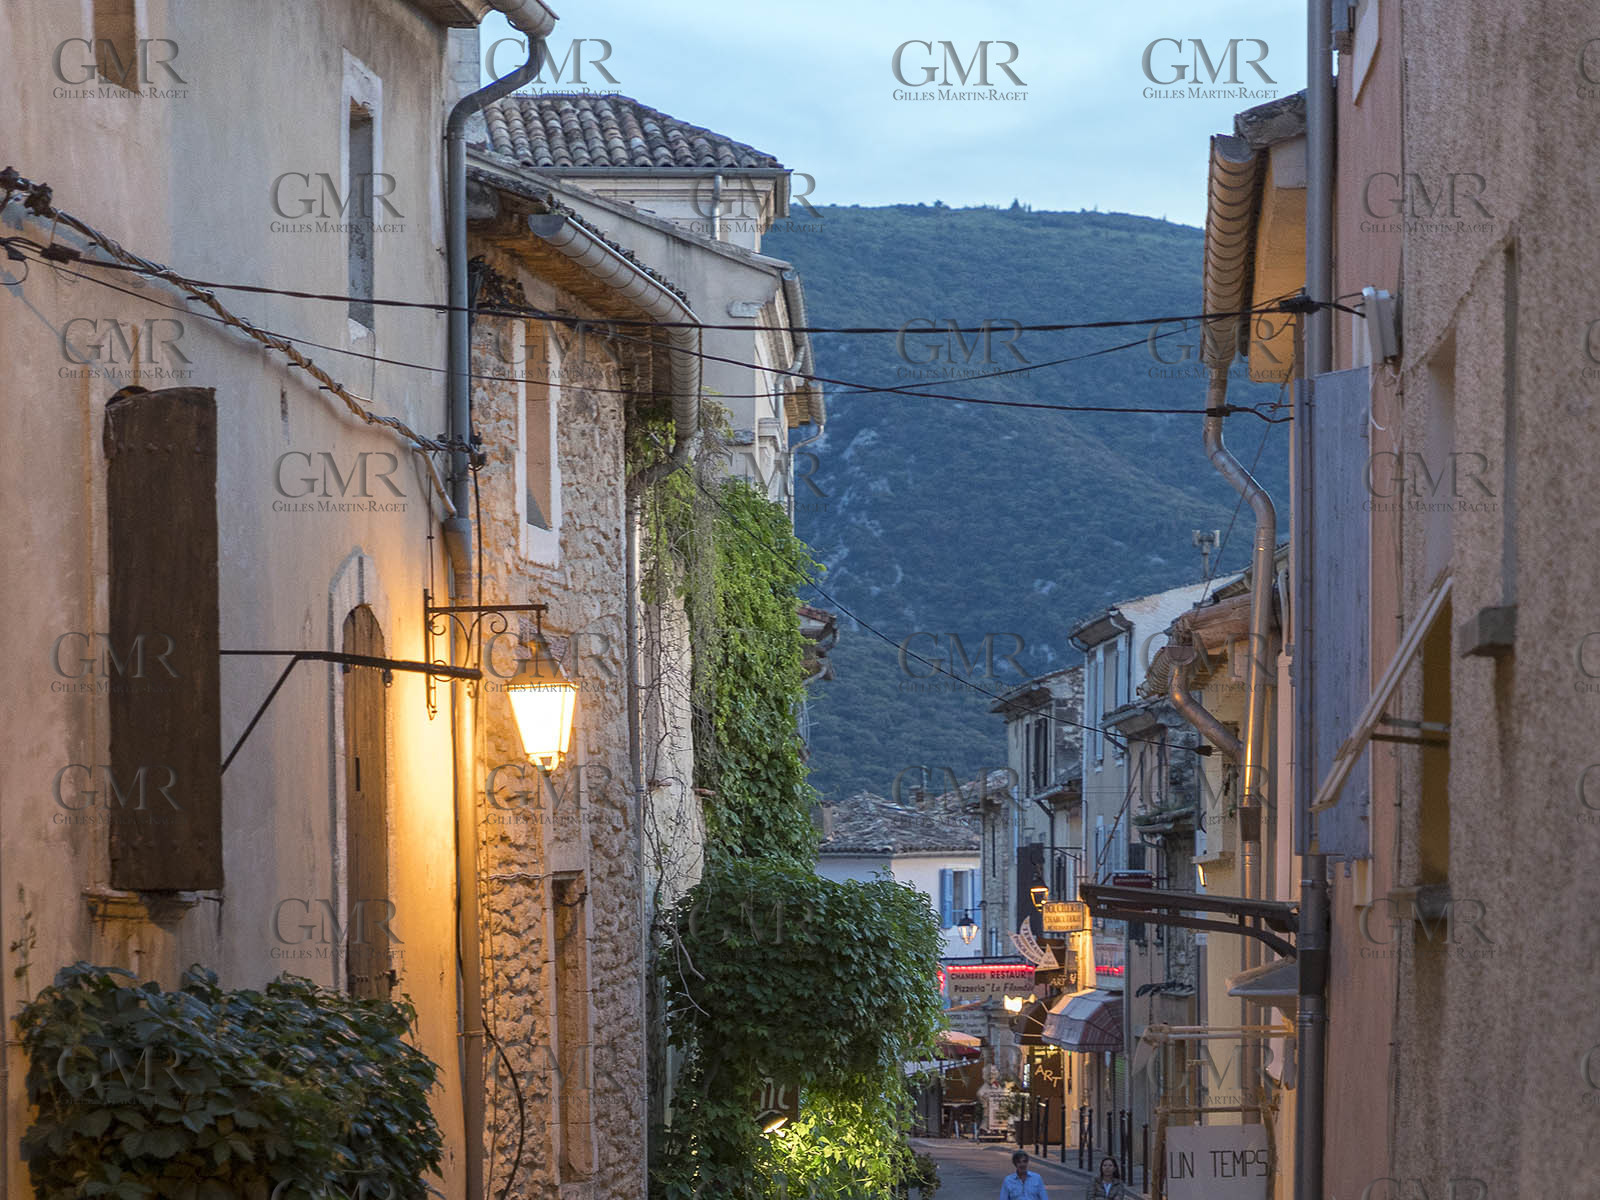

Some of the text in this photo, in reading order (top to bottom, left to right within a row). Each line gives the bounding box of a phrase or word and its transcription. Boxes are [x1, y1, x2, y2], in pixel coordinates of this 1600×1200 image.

[954, 984, 985, 993] Pizzeria
[1034, 1064, 1063, 1088] ART
[1169, 1149, 1269, 1179] UN TEMPS
